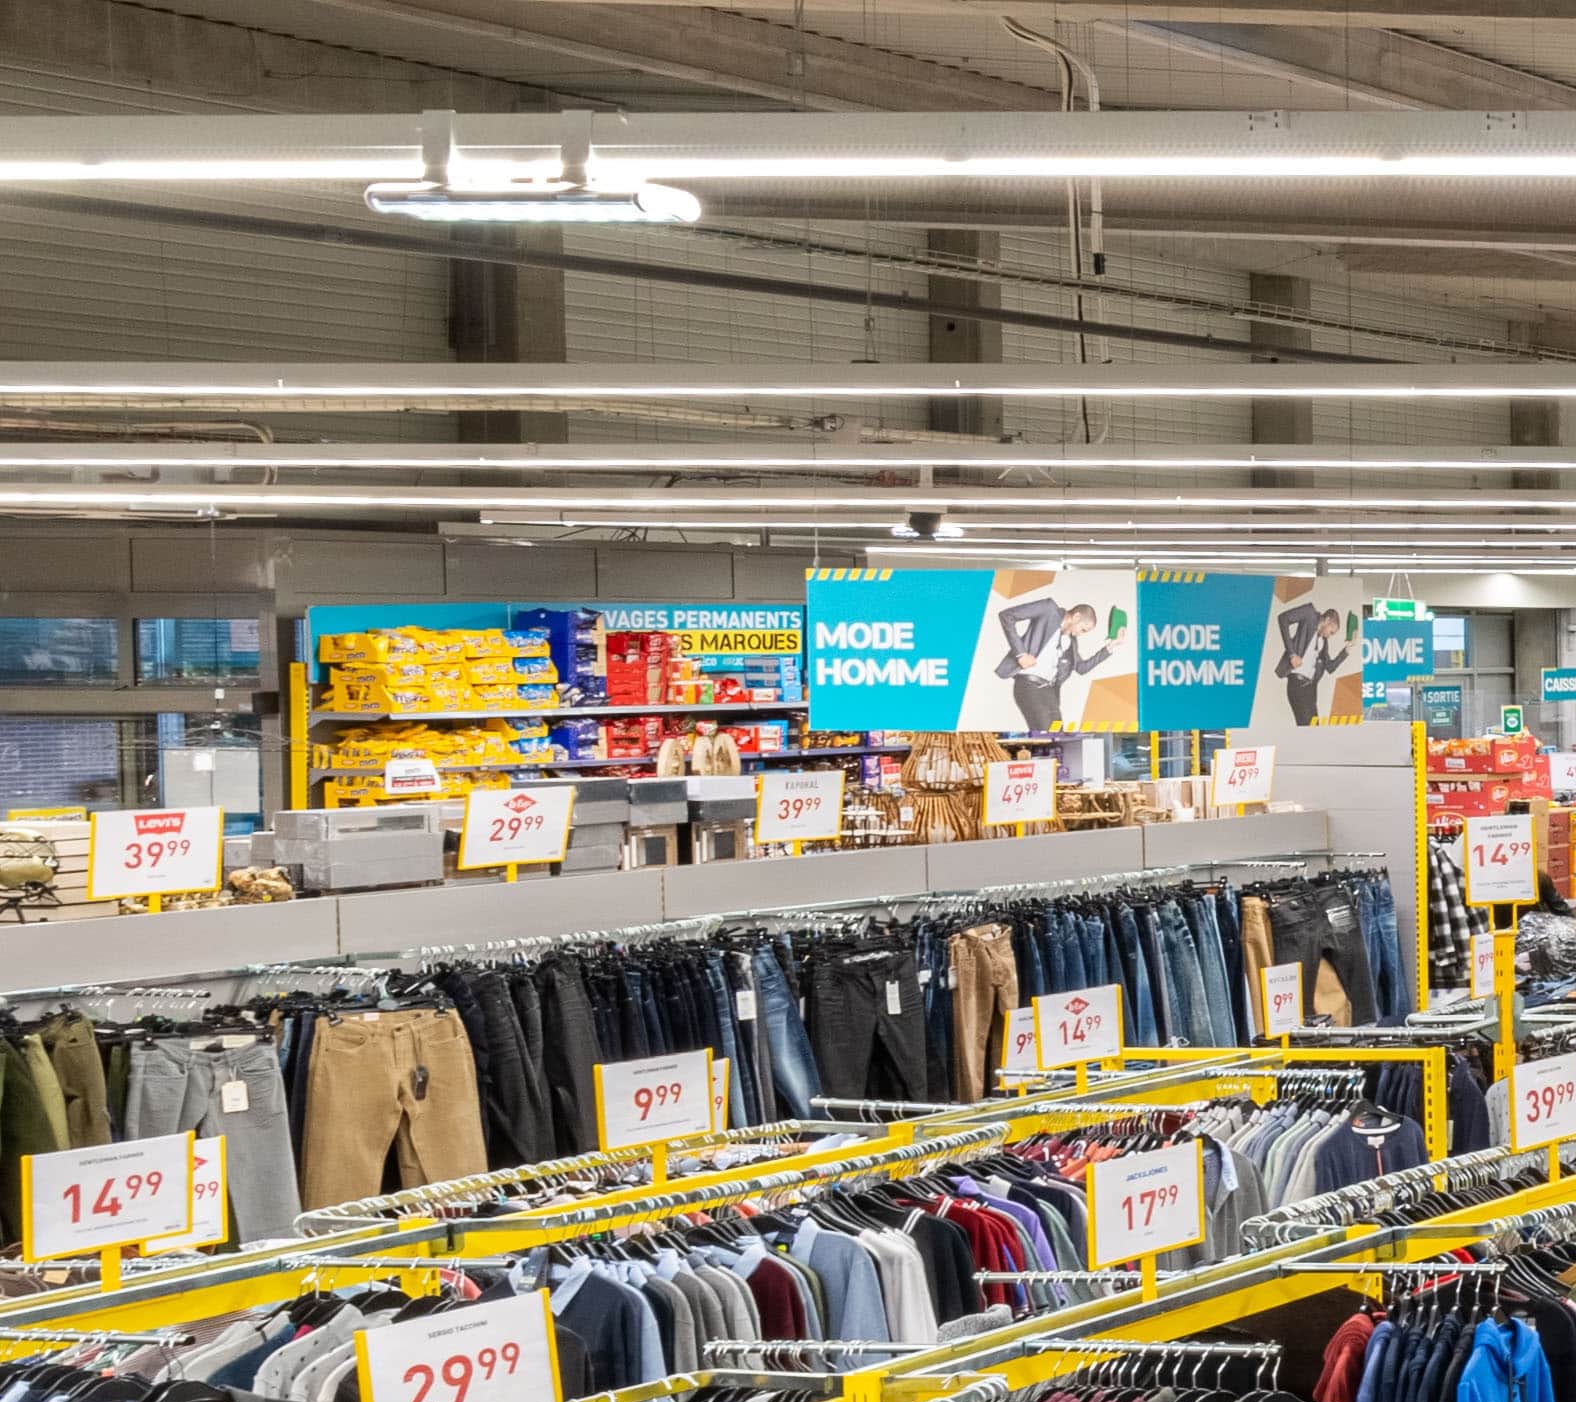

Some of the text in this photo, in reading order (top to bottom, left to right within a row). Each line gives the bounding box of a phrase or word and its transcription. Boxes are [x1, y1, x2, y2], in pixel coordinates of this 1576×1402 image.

[674, 611, 802, 631] PERMANENTS
[700, 634, 798, 651] MARQUES
[816, 622, 914, 650] MODE
[1148, 624, 1220, 651] MODE
[1362, 638, 1424, 664] OMME
[816, 659, 949, 686] HOMME
[1148, 660, 1245, 686] HOMME
